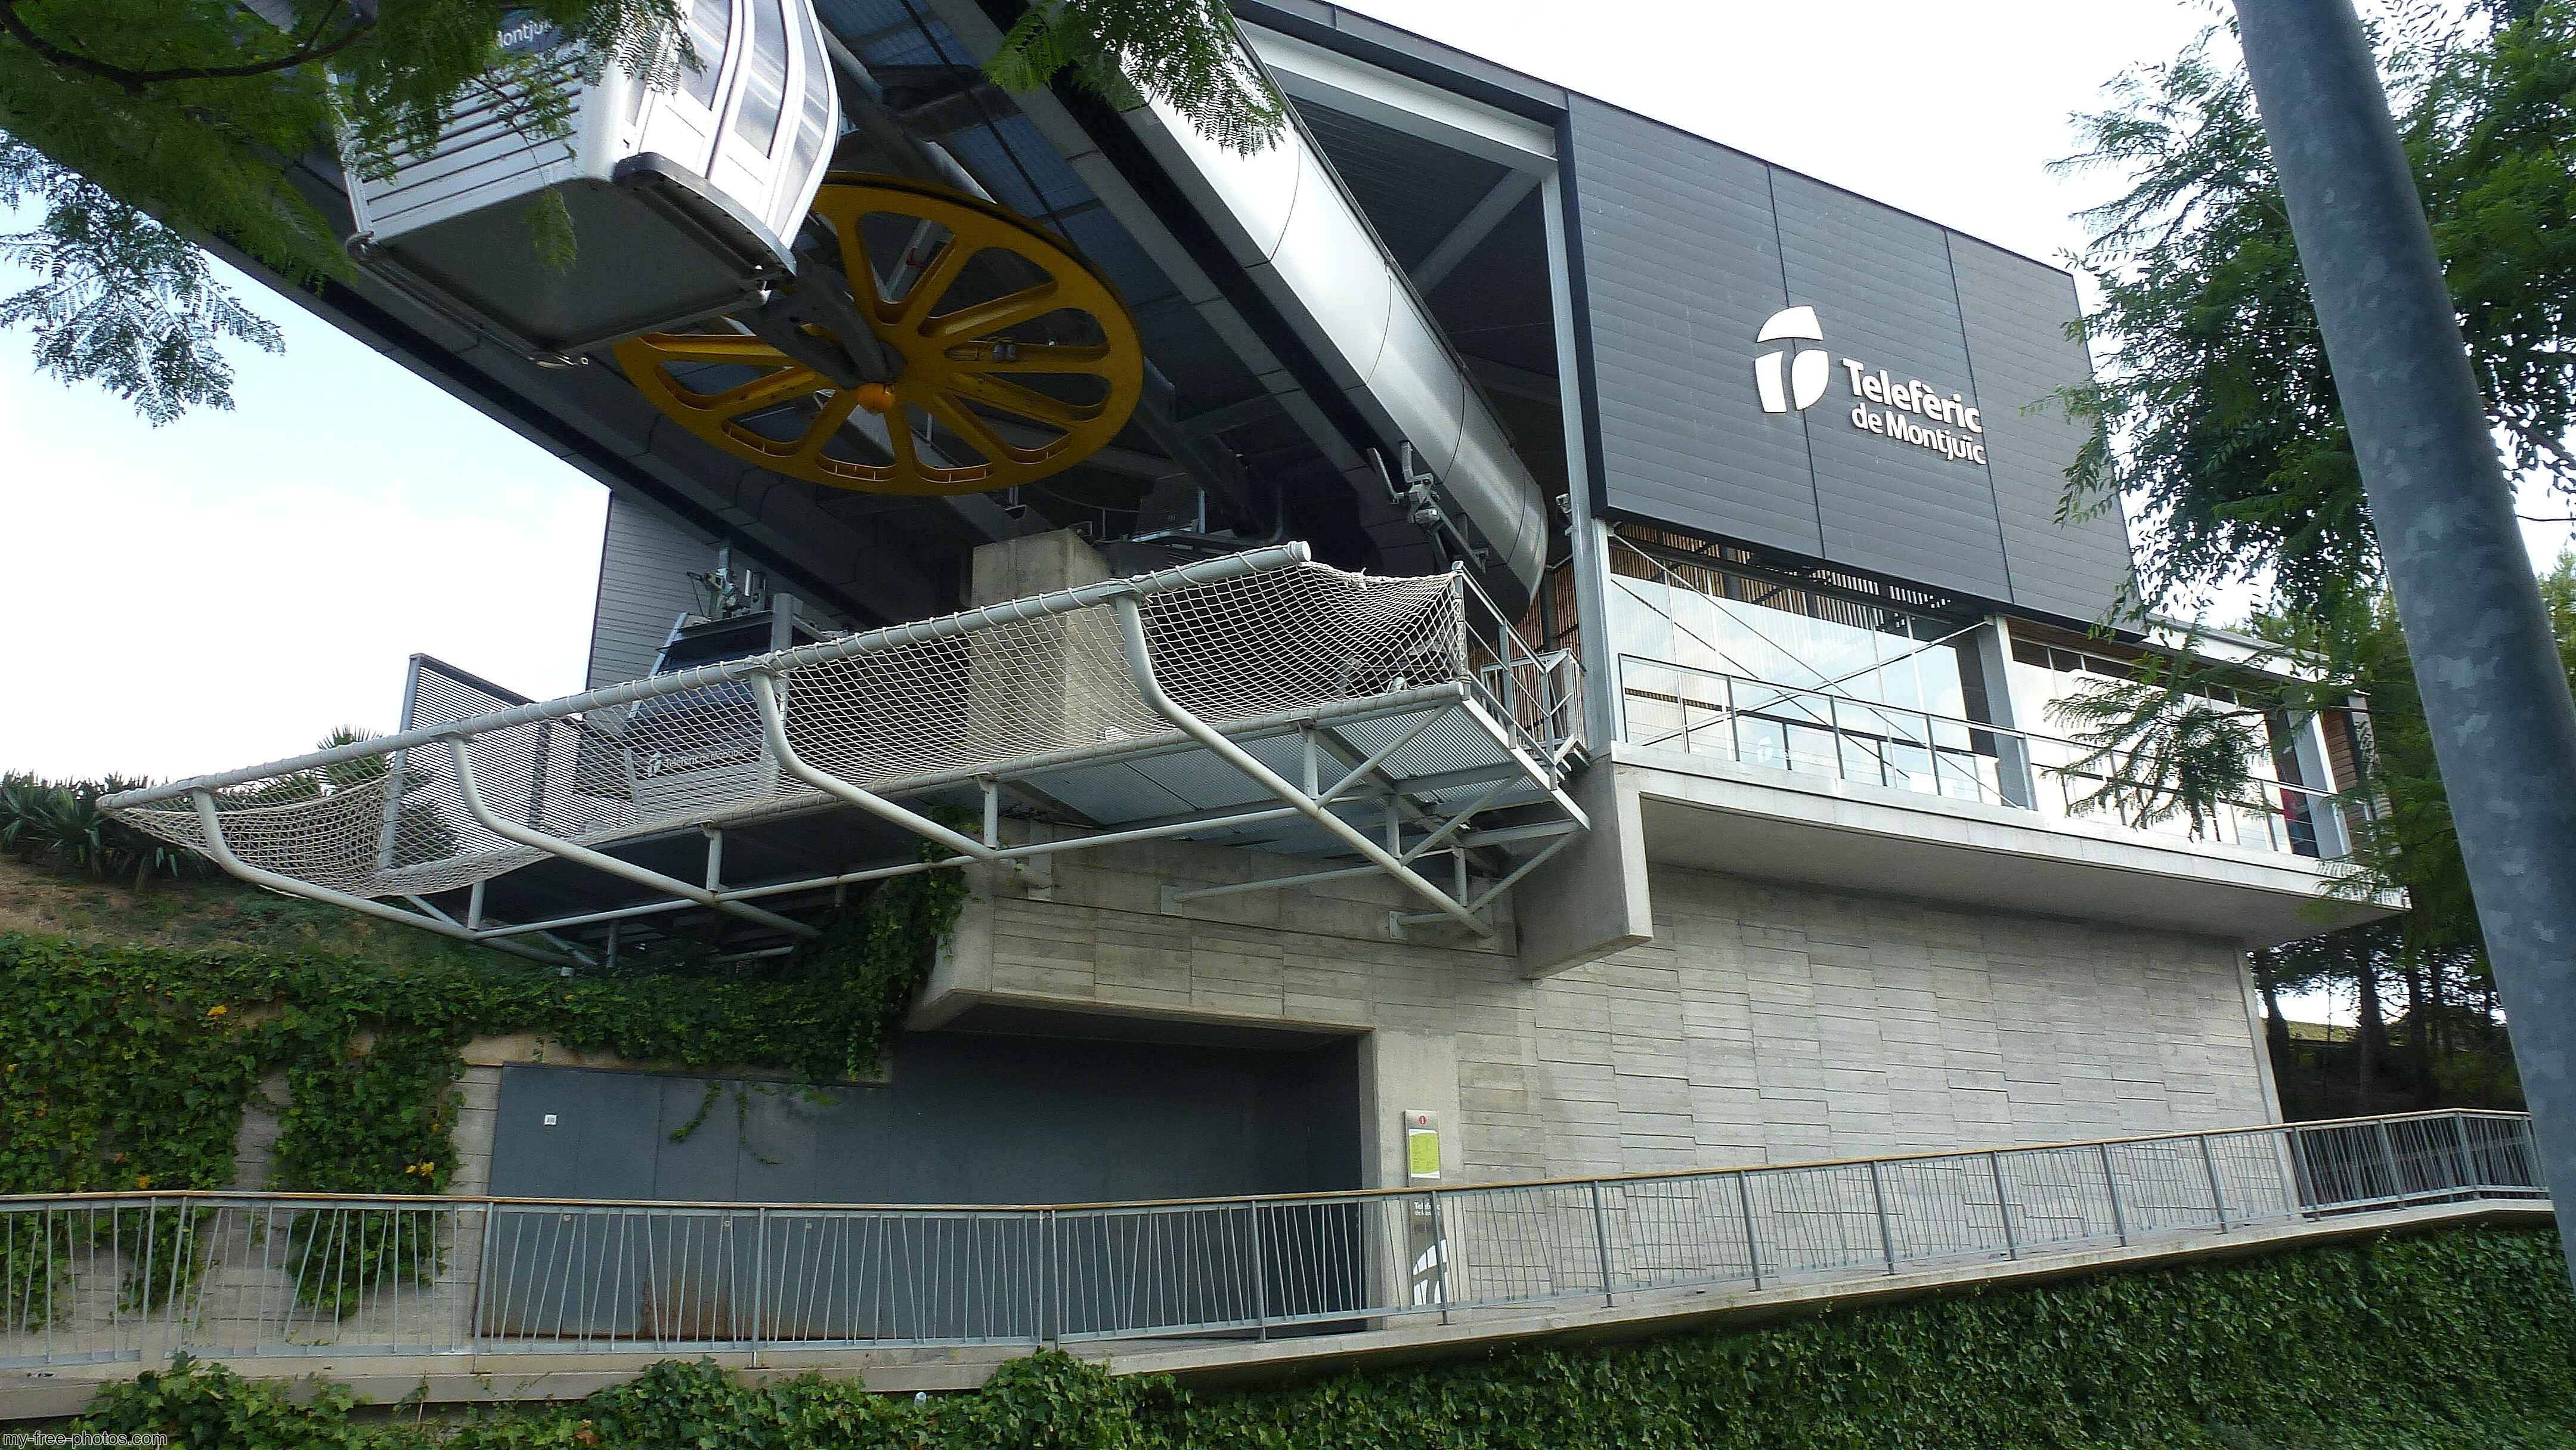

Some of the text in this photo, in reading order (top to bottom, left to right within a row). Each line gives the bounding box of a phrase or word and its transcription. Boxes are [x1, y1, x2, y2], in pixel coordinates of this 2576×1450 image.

[1842, 357, 1983, 433] Telefèric
[1852, 402, 1987, 465] de Montjuïc
